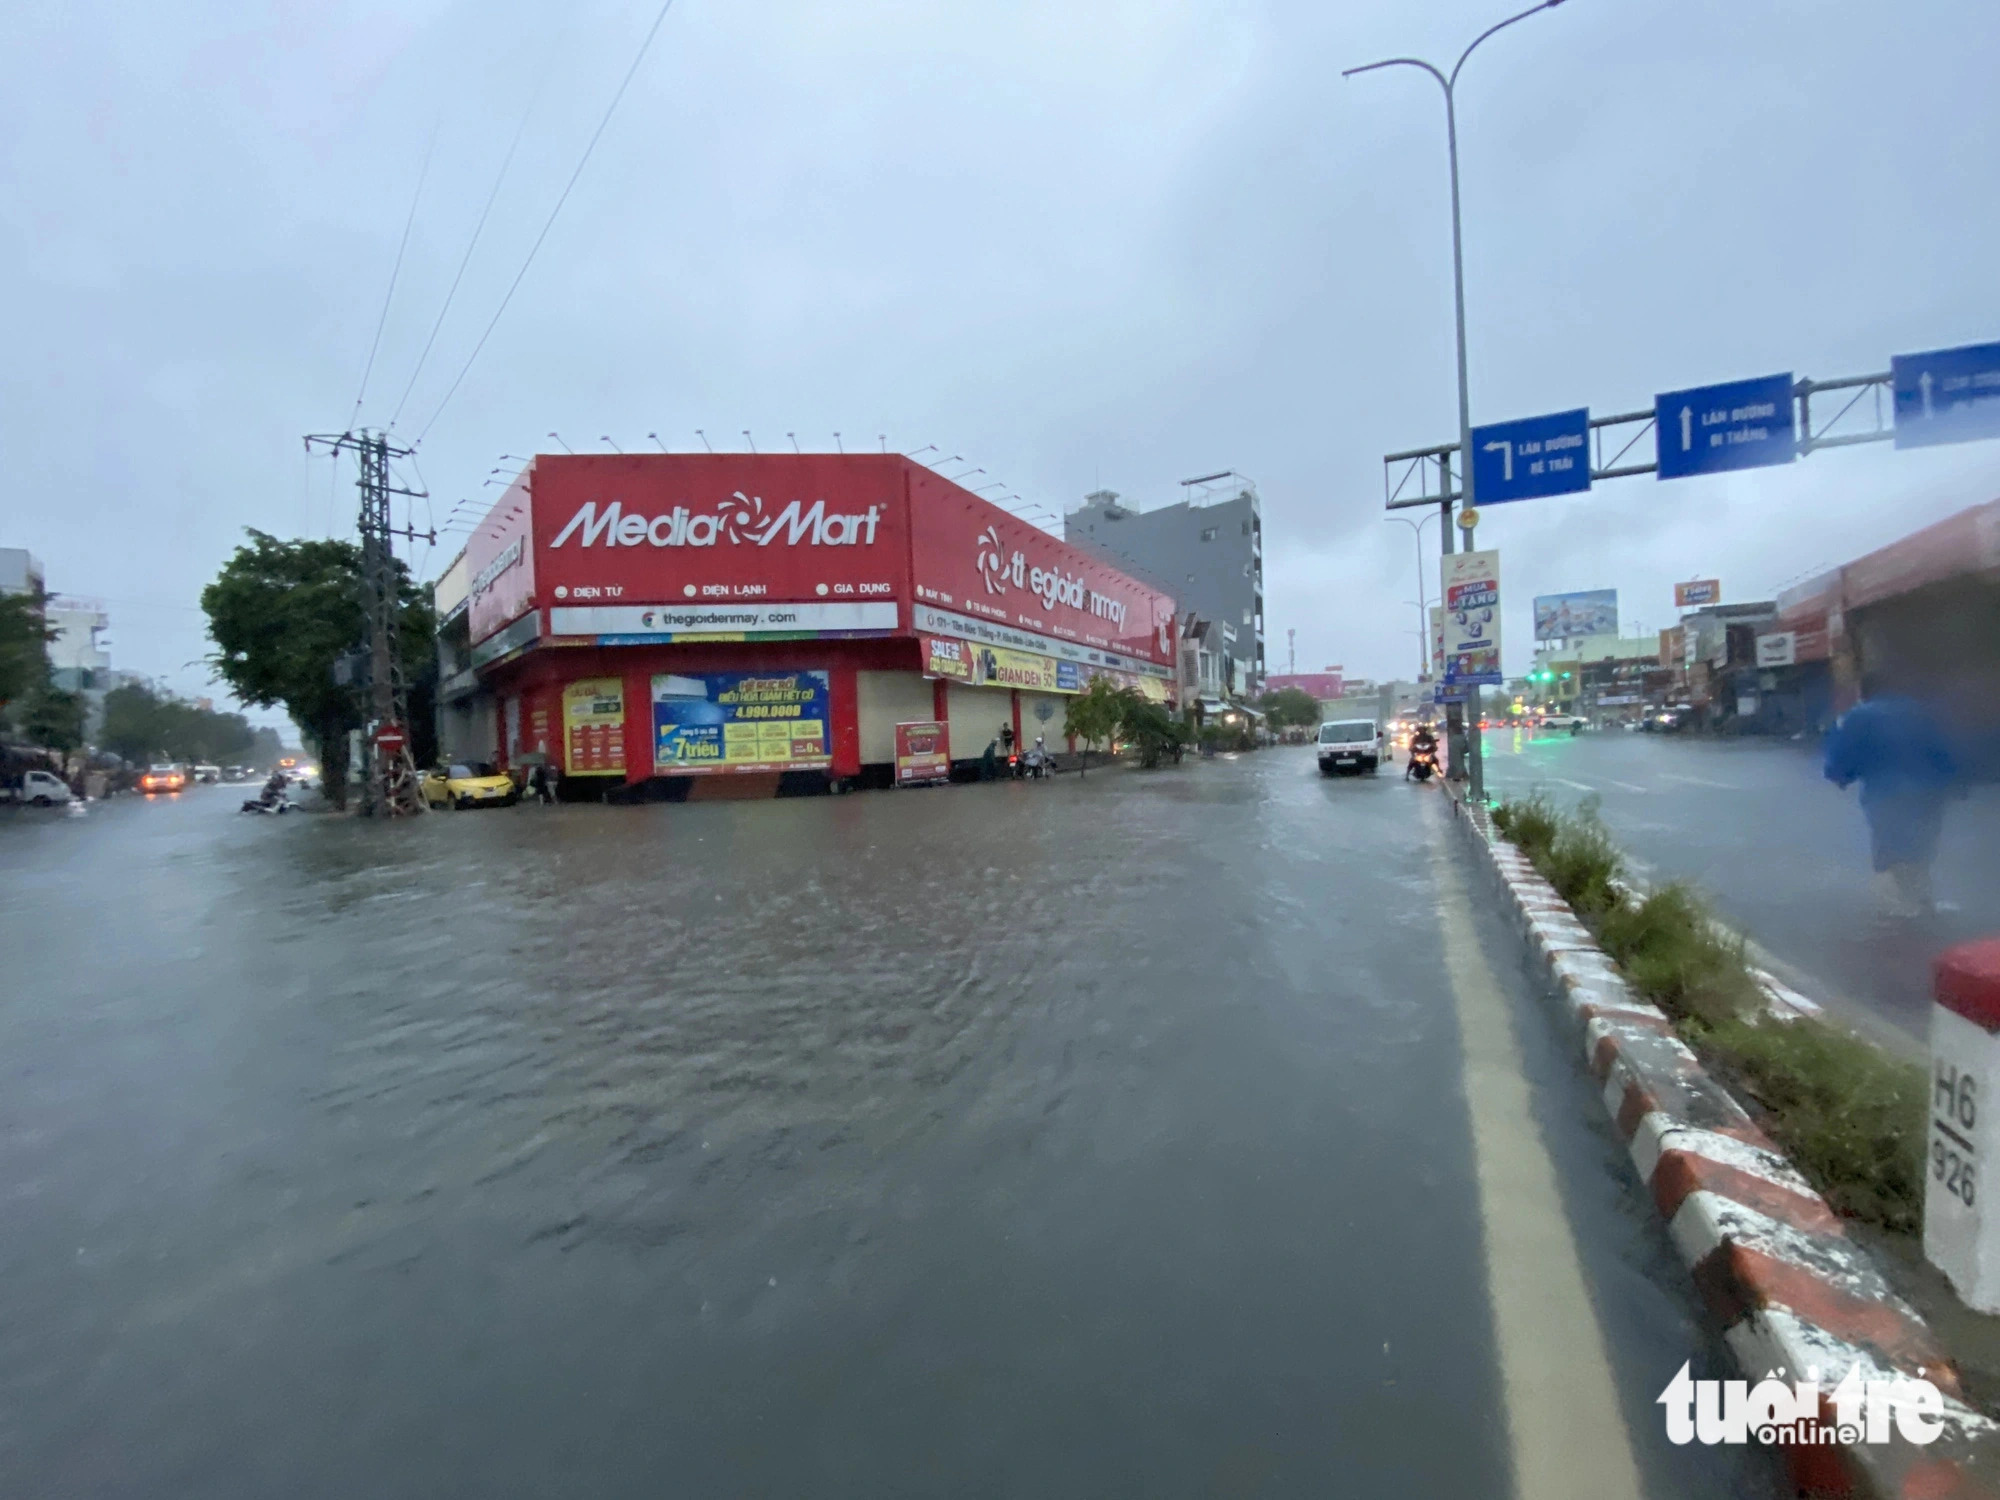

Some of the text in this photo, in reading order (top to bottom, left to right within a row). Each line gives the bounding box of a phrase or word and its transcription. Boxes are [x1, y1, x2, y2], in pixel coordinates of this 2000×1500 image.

[550, 500, 880, 548] Media Mart
[573, 586, 601, 599] ĐIỆN
[702, 584, 767, 597] ĐIỆN LẠNH
[834, 583, 891, 596] GIA DỤNG
[1934, 1059, 1977, 1130] H6
[1933, 1139, 1976, 1208] 926
